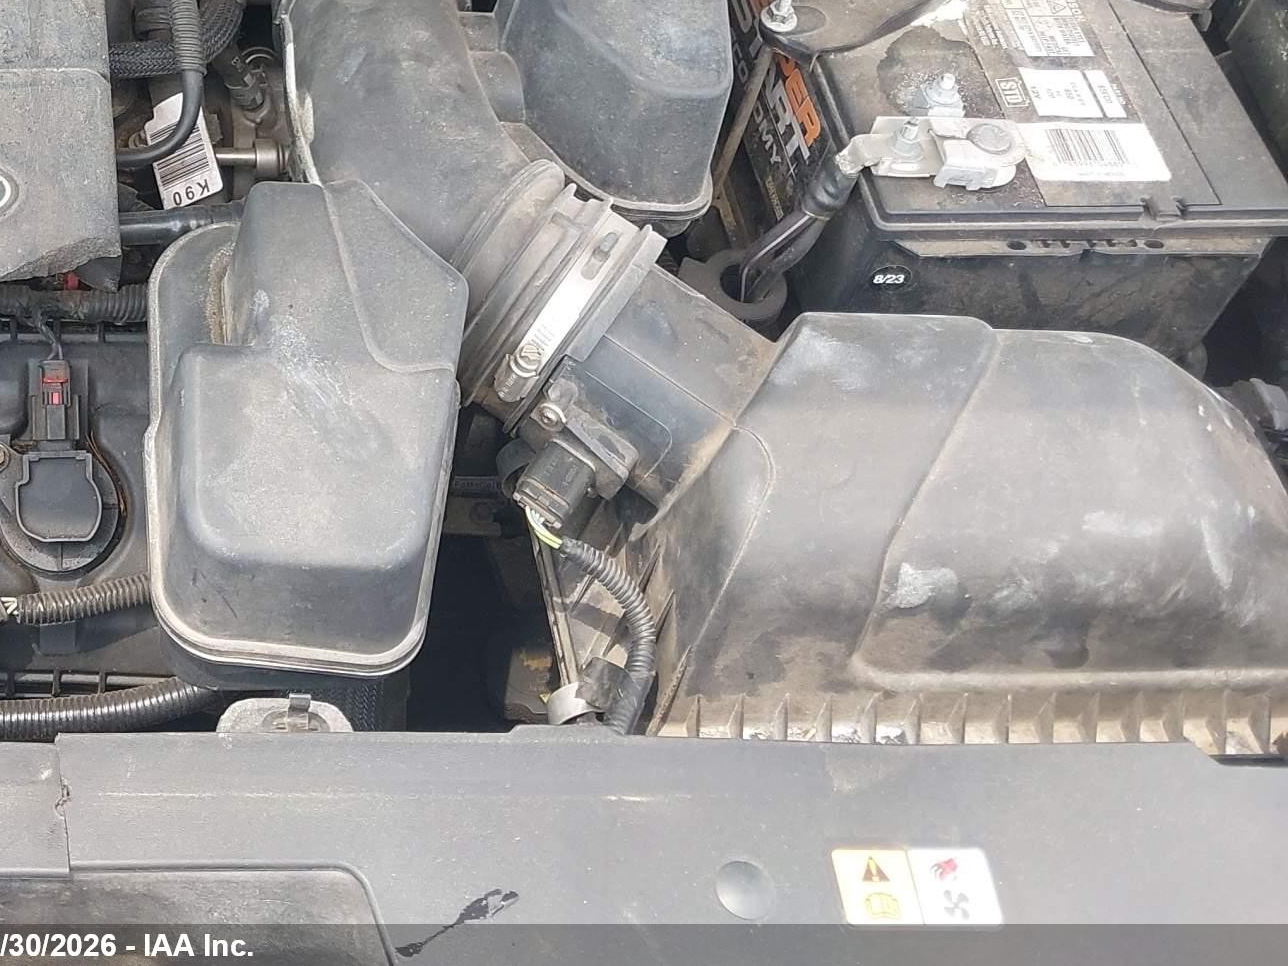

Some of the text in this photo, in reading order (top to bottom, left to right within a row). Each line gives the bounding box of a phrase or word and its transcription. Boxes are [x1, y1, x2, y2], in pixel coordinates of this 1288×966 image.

[1000, 80, 1020, 104] STD
[172, 179, 211, 206] K90
[872, 273, 906, 285] 8/23
